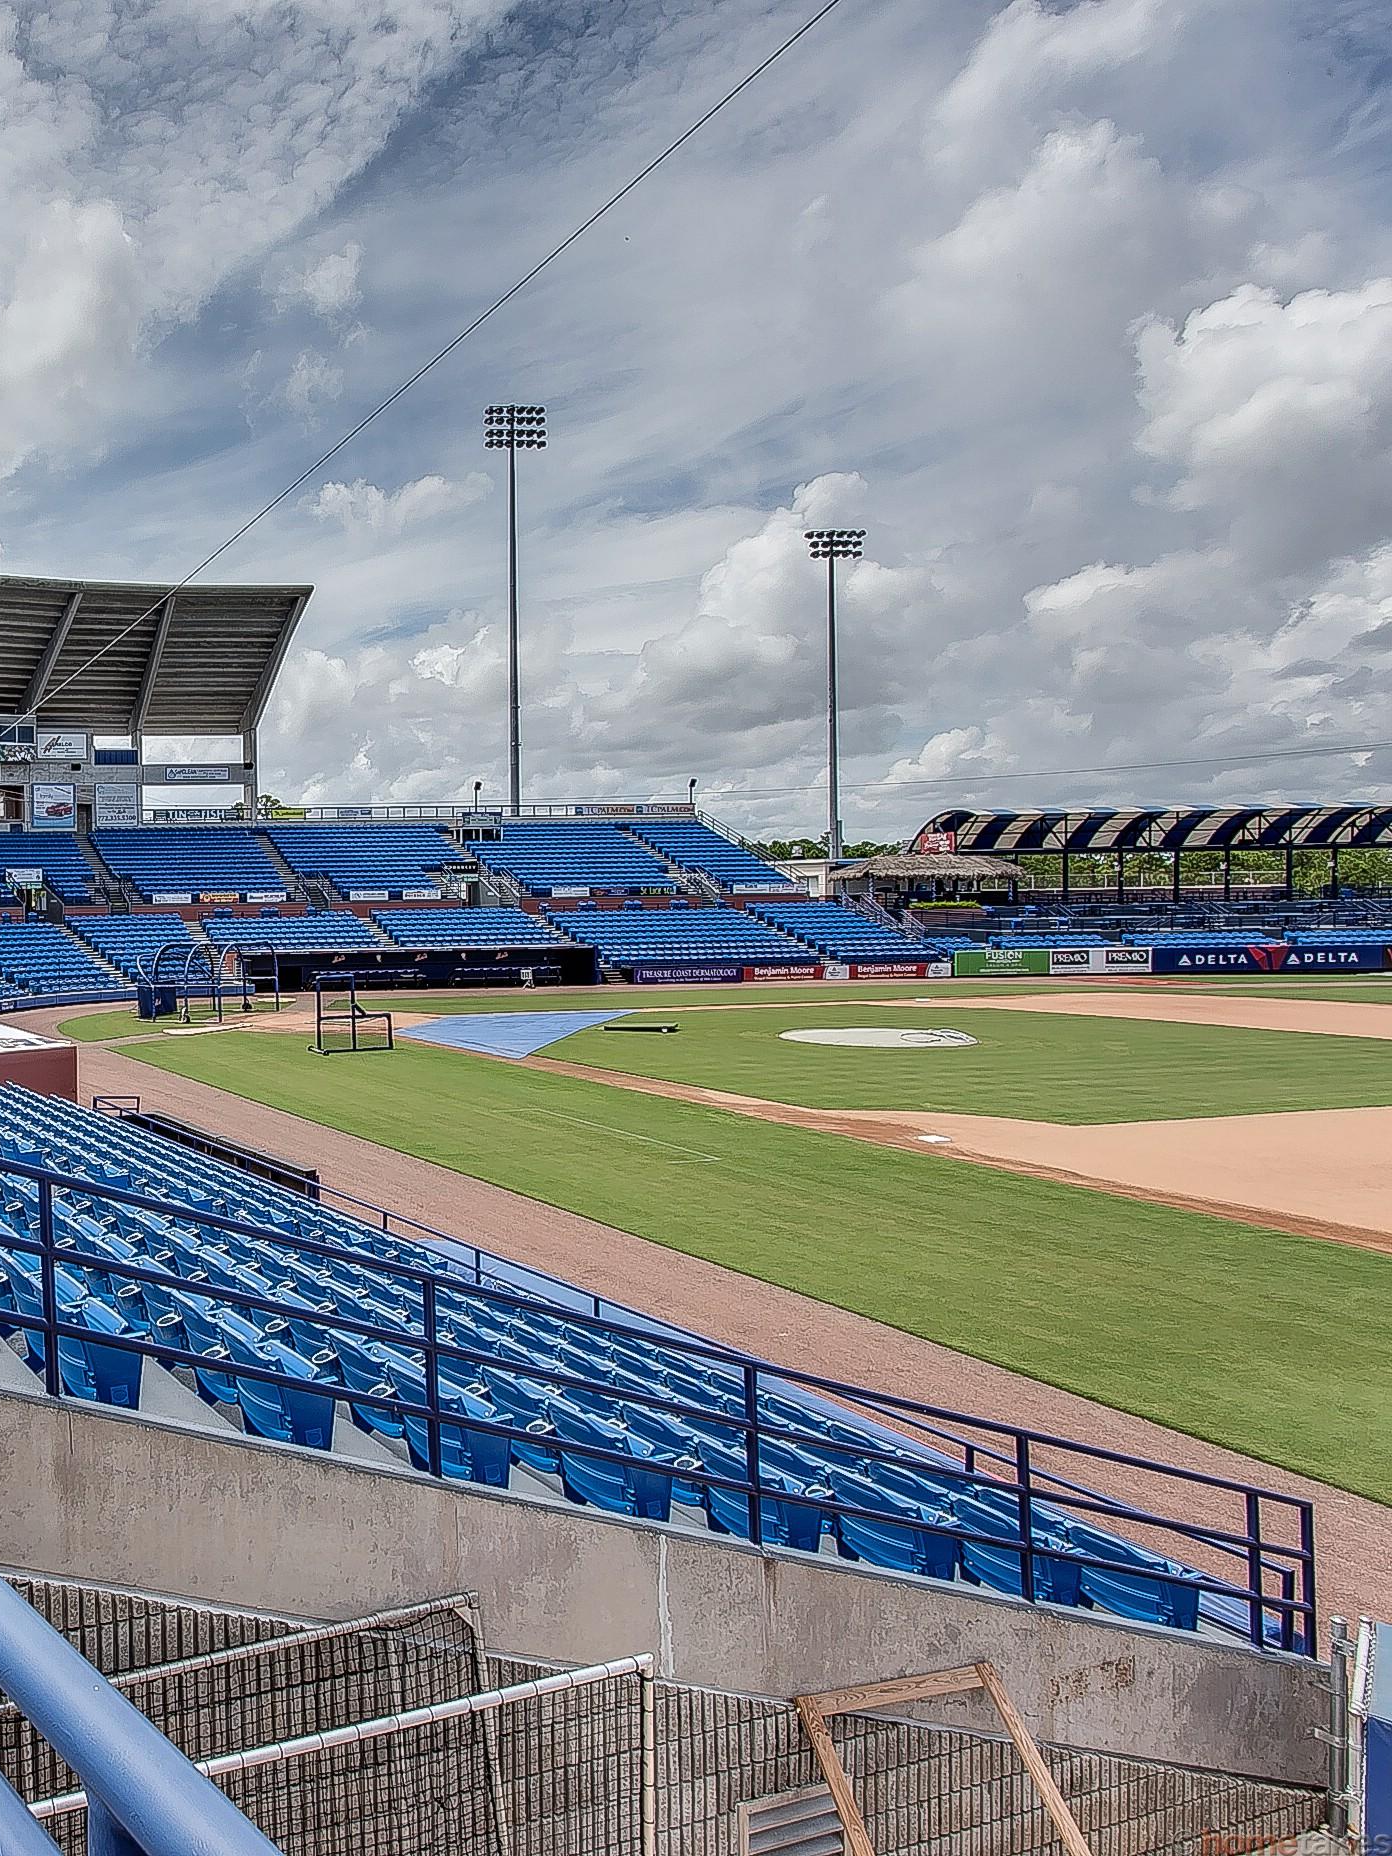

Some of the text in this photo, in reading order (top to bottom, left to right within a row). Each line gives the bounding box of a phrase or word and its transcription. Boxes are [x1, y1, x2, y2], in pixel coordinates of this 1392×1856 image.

[168, 809, 225, 819] TIN FISH
[986, 951, 1023, 960] FUSION
[1054, 953, 1088, 963] PREMIO
[1108, 951, 1147, 961] PREMIO
[1195, 954, 1248, 964] DELTA
[1304, 953, 1359, 963] DELTA
[642, 968, 737, 979] TREASURE COAST DERMATOLOGY
[755, 966, 814, 976] Benjamin Moore
[858, 964, 917, 974] Benjamin Moore
